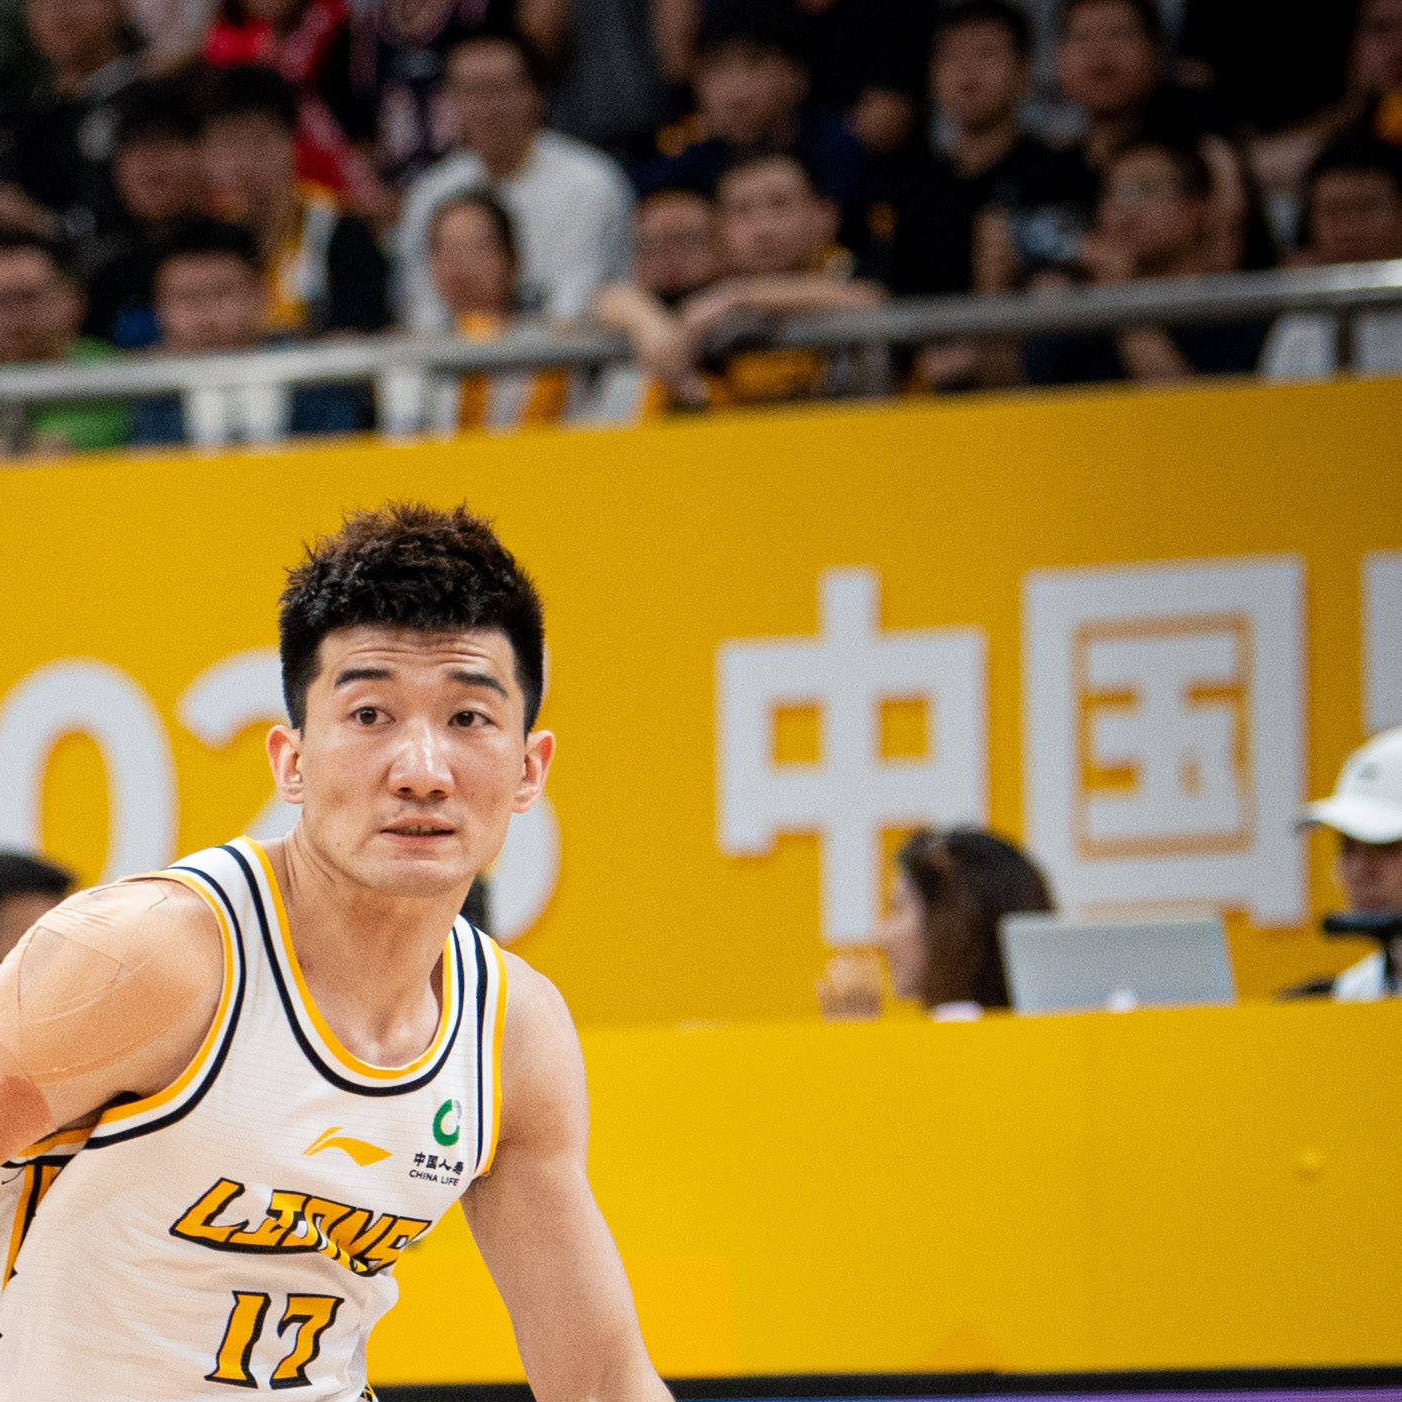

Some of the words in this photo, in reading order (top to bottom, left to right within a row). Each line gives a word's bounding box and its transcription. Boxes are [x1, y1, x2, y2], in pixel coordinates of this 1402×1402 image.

[715, 548, 1402, 948] 中国
[409, 1169, 438, 1183] CHINA
[440, 1175, 459, 1187] LIFE
[413, 1151, 464, 1176] 中国人寿
[204, 1290, 345, 1390] 17
